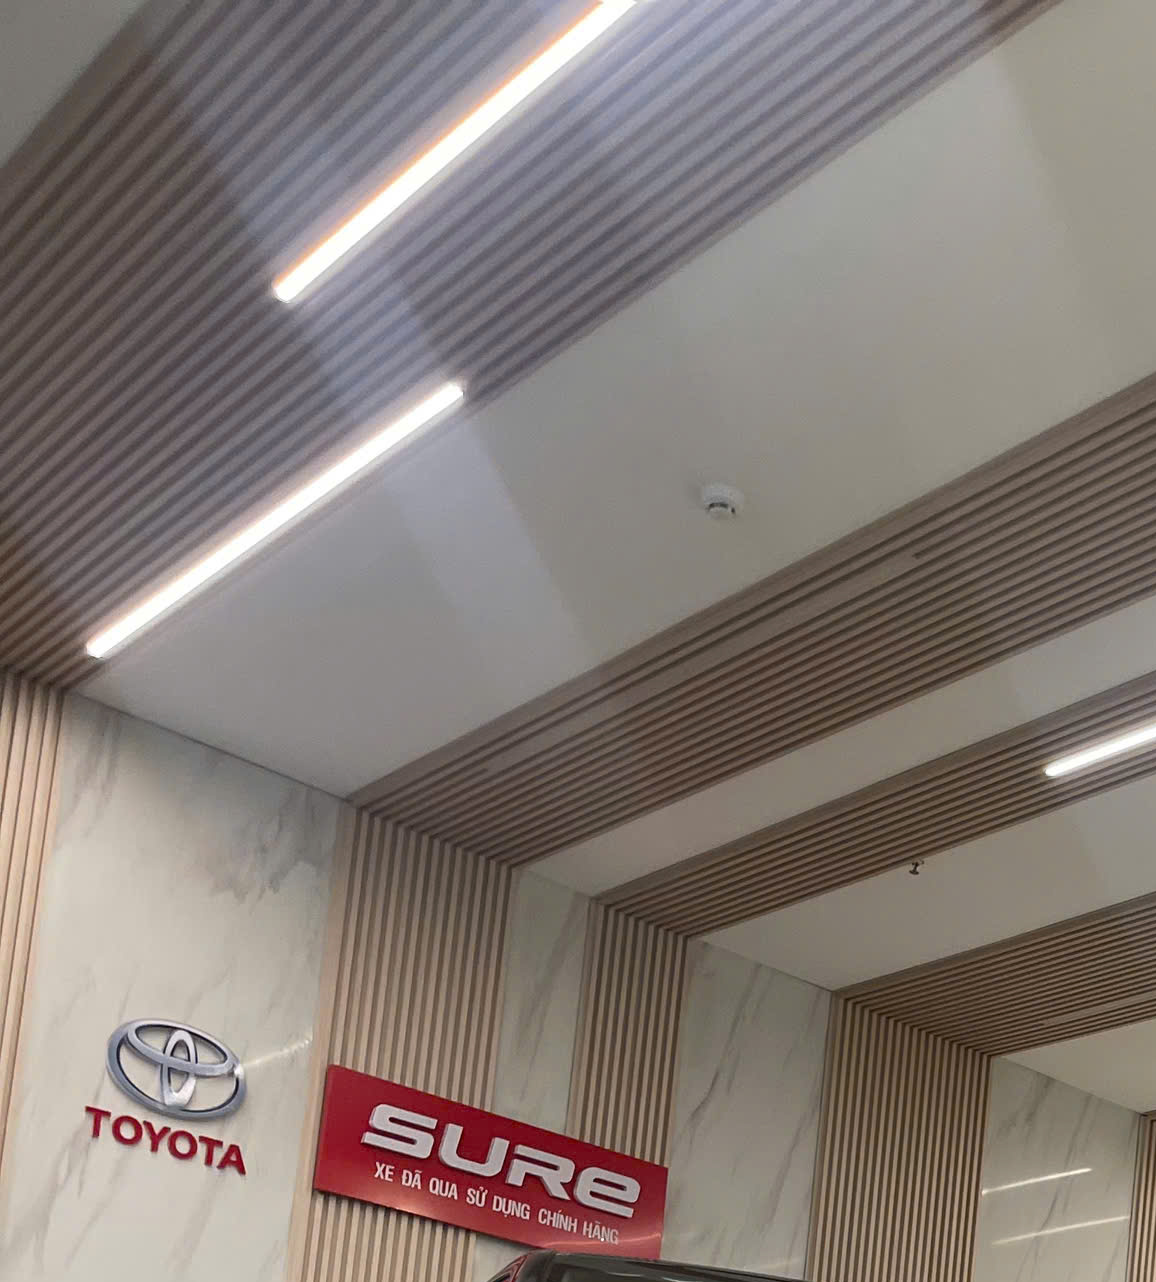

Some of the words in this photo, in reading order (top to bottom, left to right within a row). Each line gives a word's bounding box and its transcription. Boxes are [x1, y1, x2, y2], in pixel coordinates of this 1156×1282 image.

[85, 1106, 246, 1176] TOYOTA
[374, 1161, 395, 1182] XE
[401, 1169, 423, 1190] ĐÃ
[429, 1177, 458, 1200] QUA
[466, 1186, 488, 1207] SỬ
[492, 1195, 531, 1220] DỤNG
[538, 1208, 578, 1232] CHÍNH
